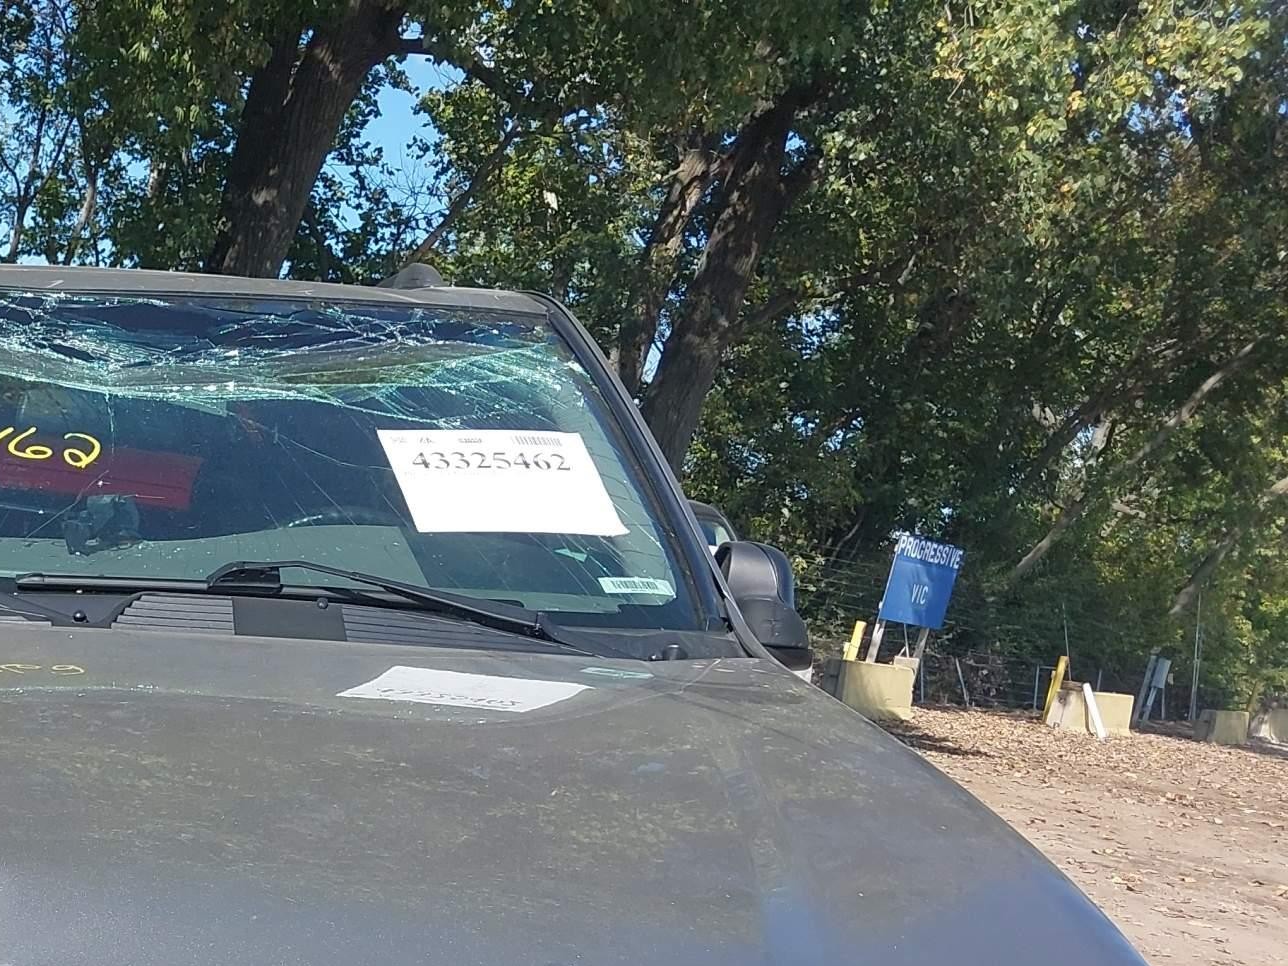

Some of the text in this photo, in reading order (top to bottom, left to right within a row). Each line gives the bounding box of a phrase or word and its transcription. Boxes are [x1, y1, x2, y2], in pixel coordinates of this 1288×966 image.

[411, 451, 572, 472] 43325462
[898, 536, 963, 569] PROGRESSIVE
[911, 583, 929, 605] VIC
